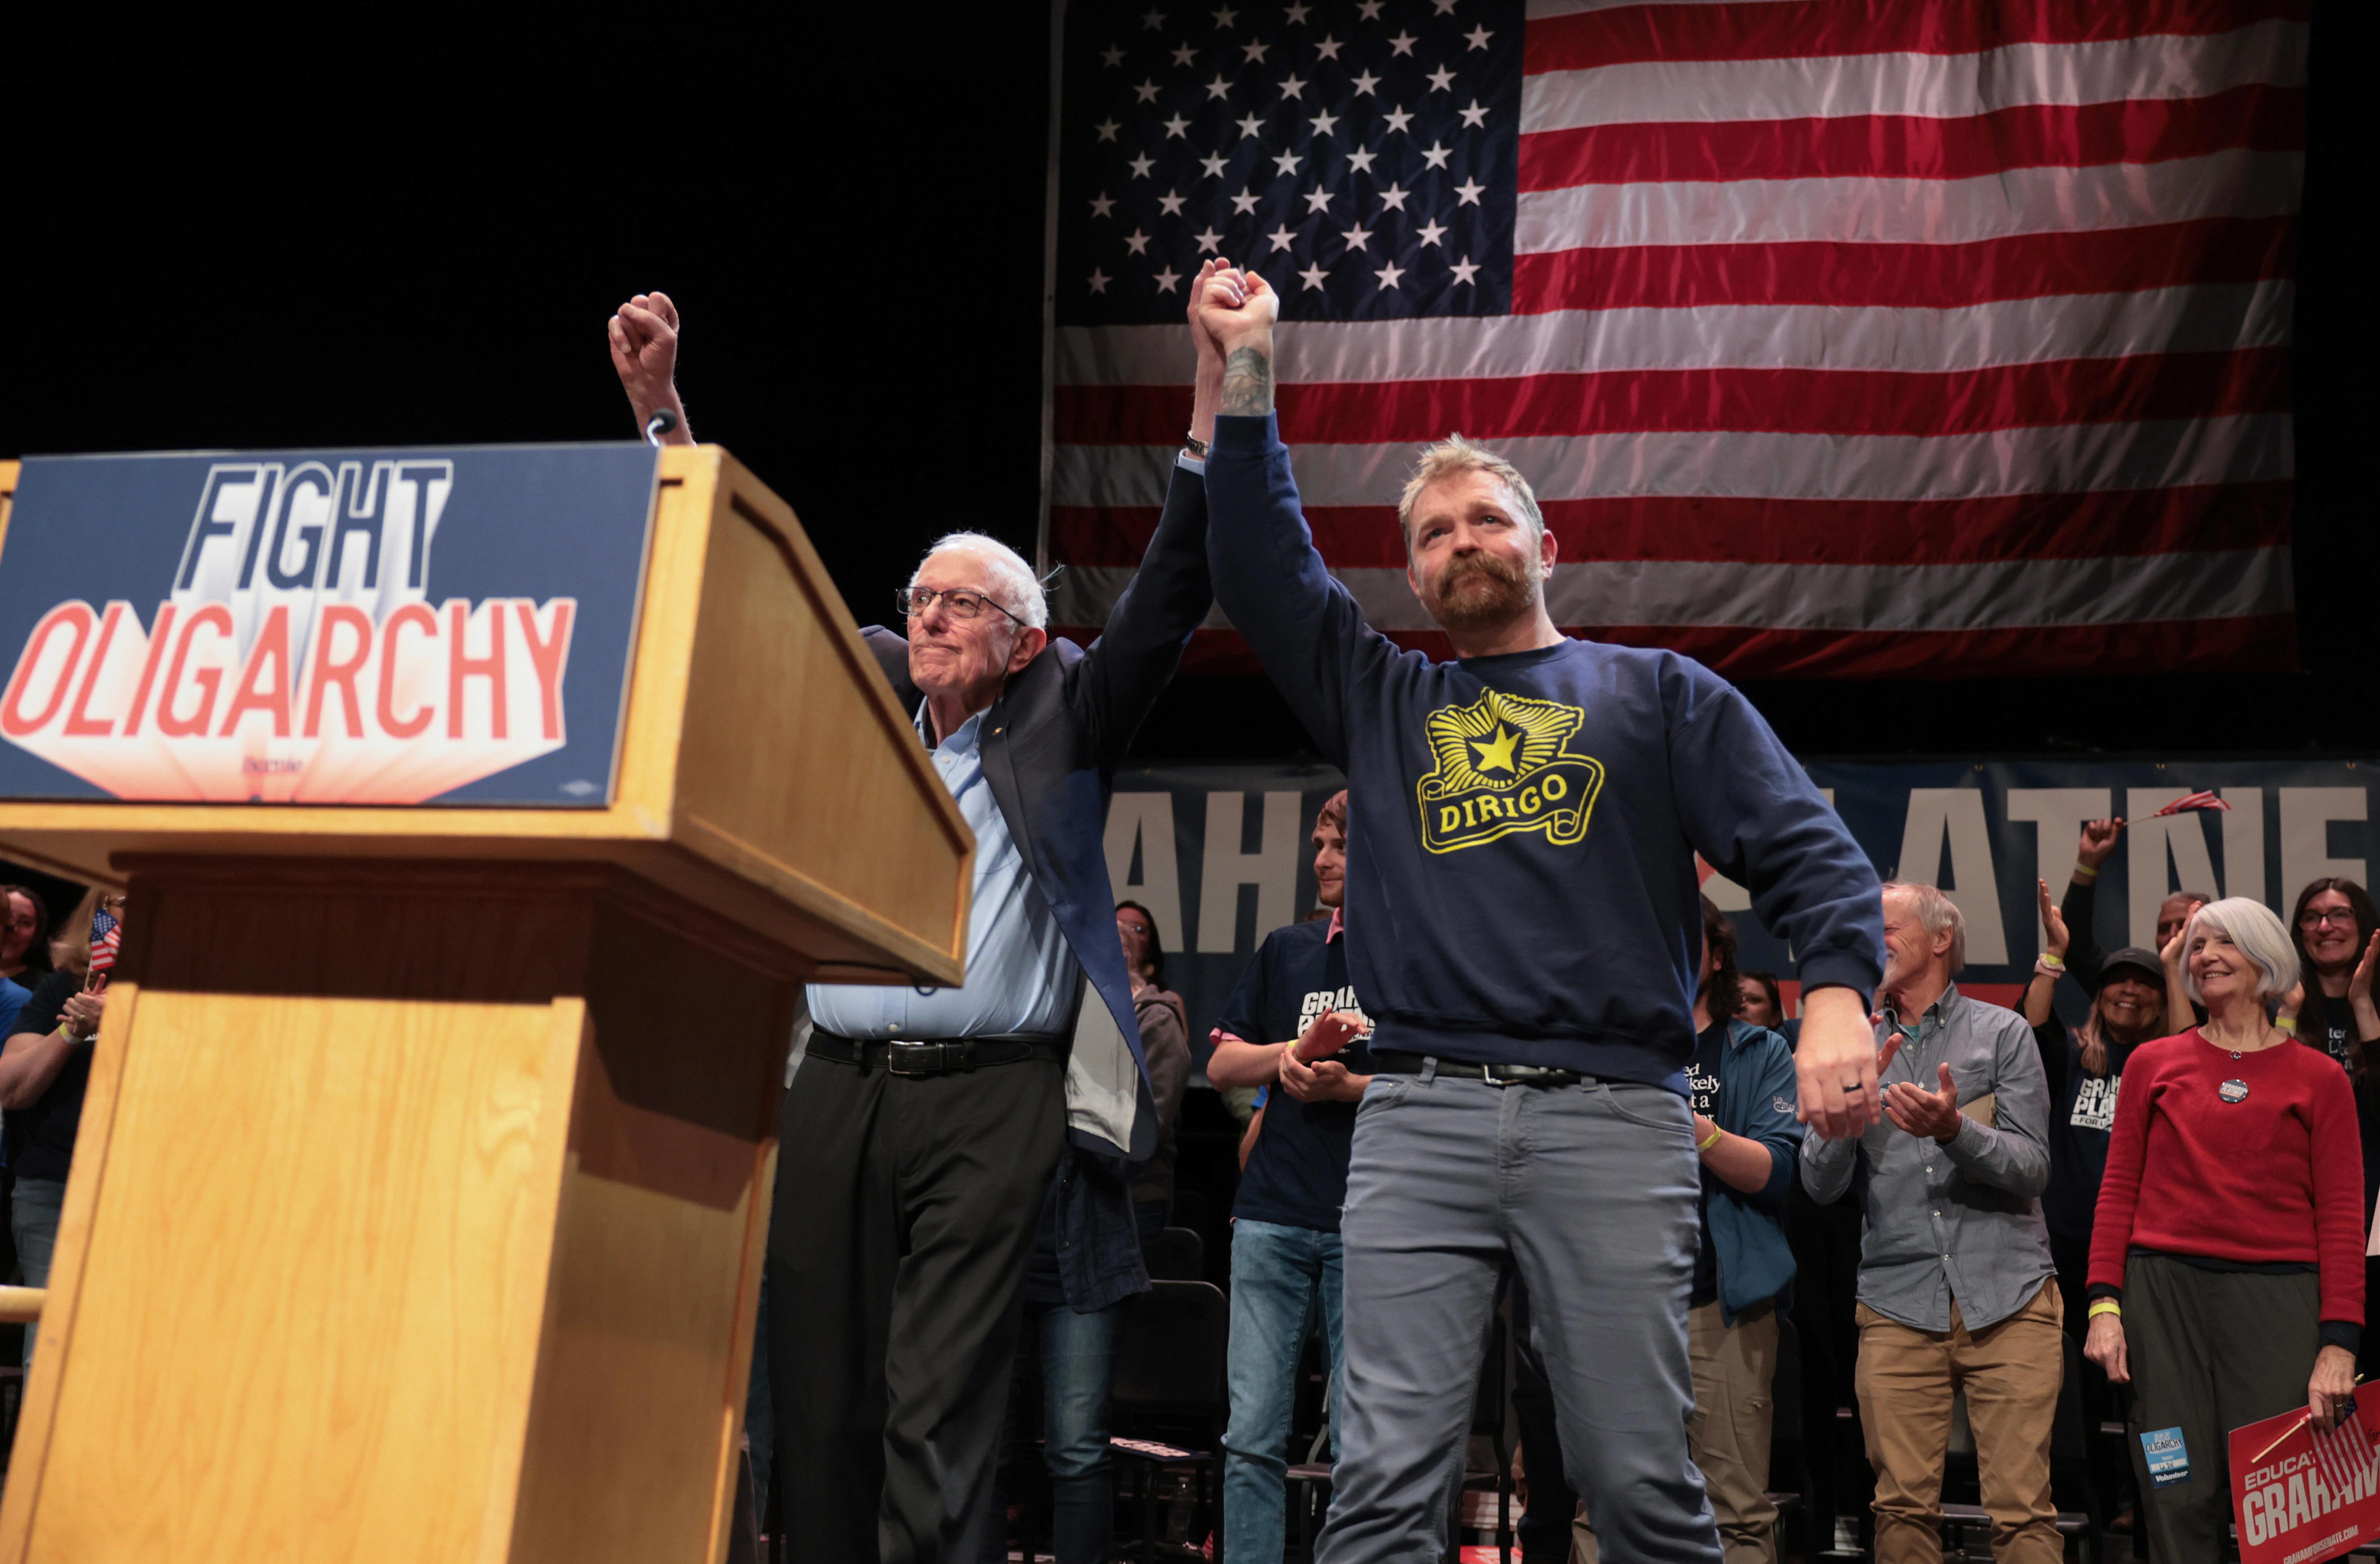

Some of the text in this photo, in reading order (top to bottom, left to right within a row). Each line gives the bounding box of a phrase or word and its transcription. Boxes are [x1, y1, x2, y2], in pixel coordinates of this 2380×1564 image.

[172, 460, 453, 591] FIGHT
[1, 603, 573, 741] OLIGARCHY
[1440, 774, 1567, 833] DIRIGO
[1103, 791, 1302, 953] AH
[1687, 1075, 1720, 1093] kely
[1700, 1095, 1710, 1109] a
[2146, 1438, 2182, 1452] OLIGARCHY
[2155, 1470, 2188, 1482] Volunteer
[2245, 1450, 2316, 1490] EDUCA
